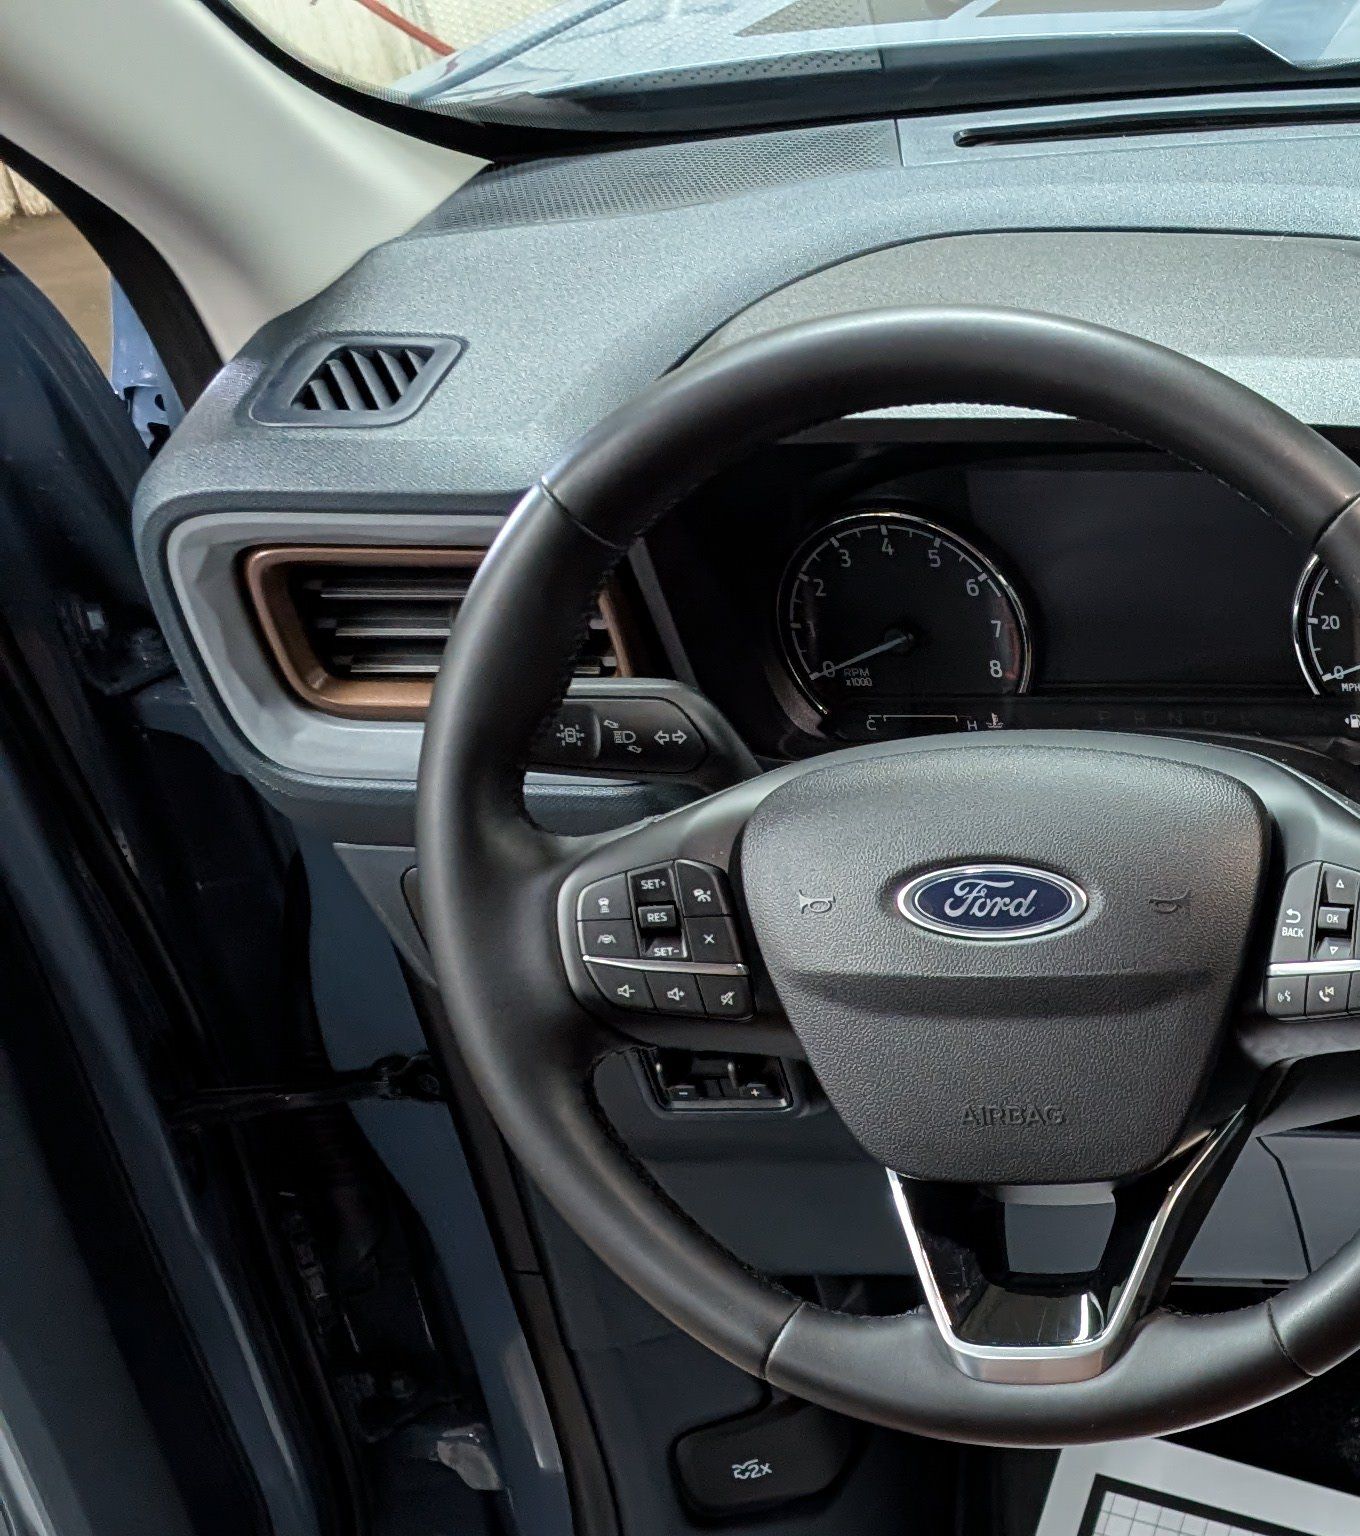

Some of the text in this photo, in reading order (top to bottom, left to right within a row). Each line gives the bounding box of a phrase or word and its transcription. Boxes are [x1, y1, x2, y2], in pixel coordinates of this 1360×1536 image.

[882, 538, 894, 556] 4
[839, 550, 851, 568] 3
[928, 550, 941, 568] 5
[813, 579, 826, 597] 2
[966, 579, 979, 597] 6
[990, 620, 1002, 638] 7
[1321, 615, 1340, 630] 20
[843, 668, 870, 677] RPM
[989, 660, 1003, 678] 8
[1341, 683, 1360, 692] MPH
[866, 720, 877, 731] C
[967, 720, 978, 731] H
[944, 879, 1038, 917] Ford
[646, 912, 668, 922] RES
[1326, 913, 1339, 924] OK
[1281, 927, 1304, 938] BACK
[960, 1105, 1066, 1126] AIRBAG
